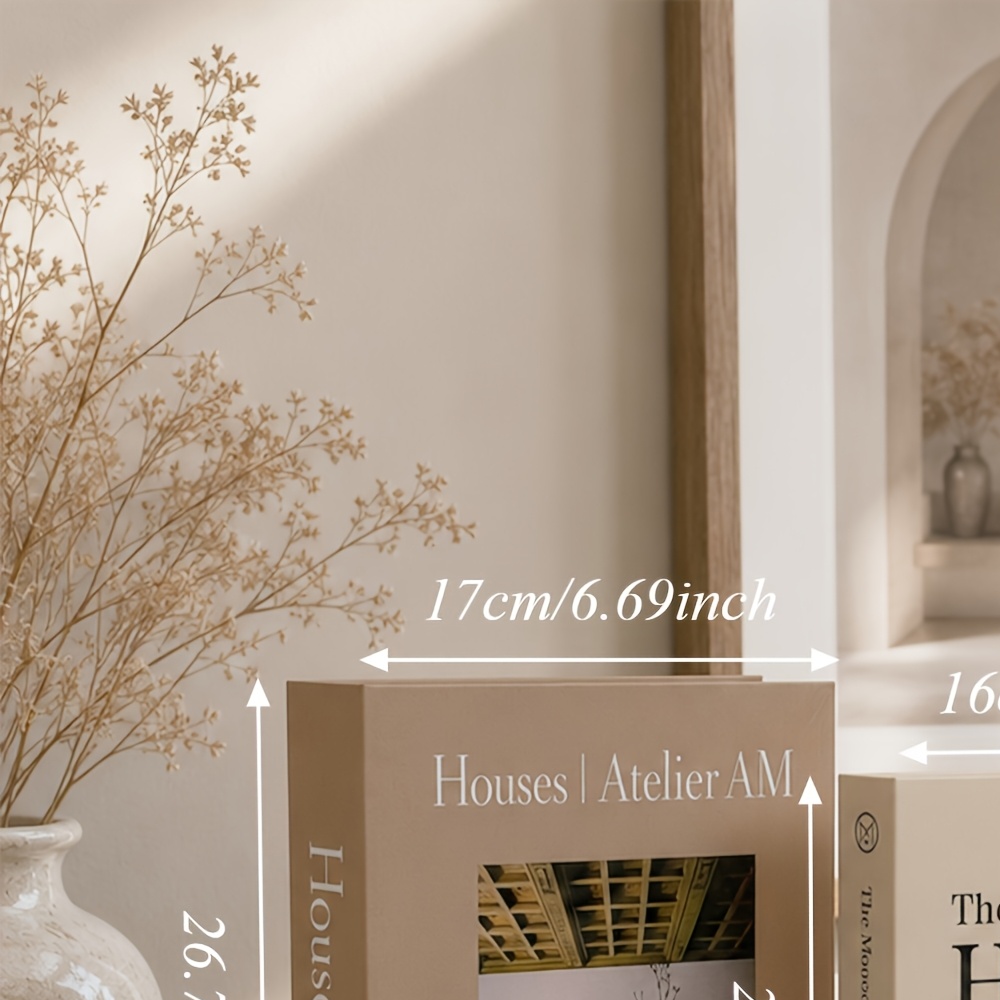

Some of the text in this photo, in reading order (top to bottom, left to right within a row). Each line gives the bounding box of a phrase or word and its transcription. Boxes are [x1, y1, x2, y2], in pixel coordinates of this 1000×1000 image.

[433, 753, 569, 808] Houses
[598, 750, 720, 803] Atelier
[725, 748, 795, 799] AM
